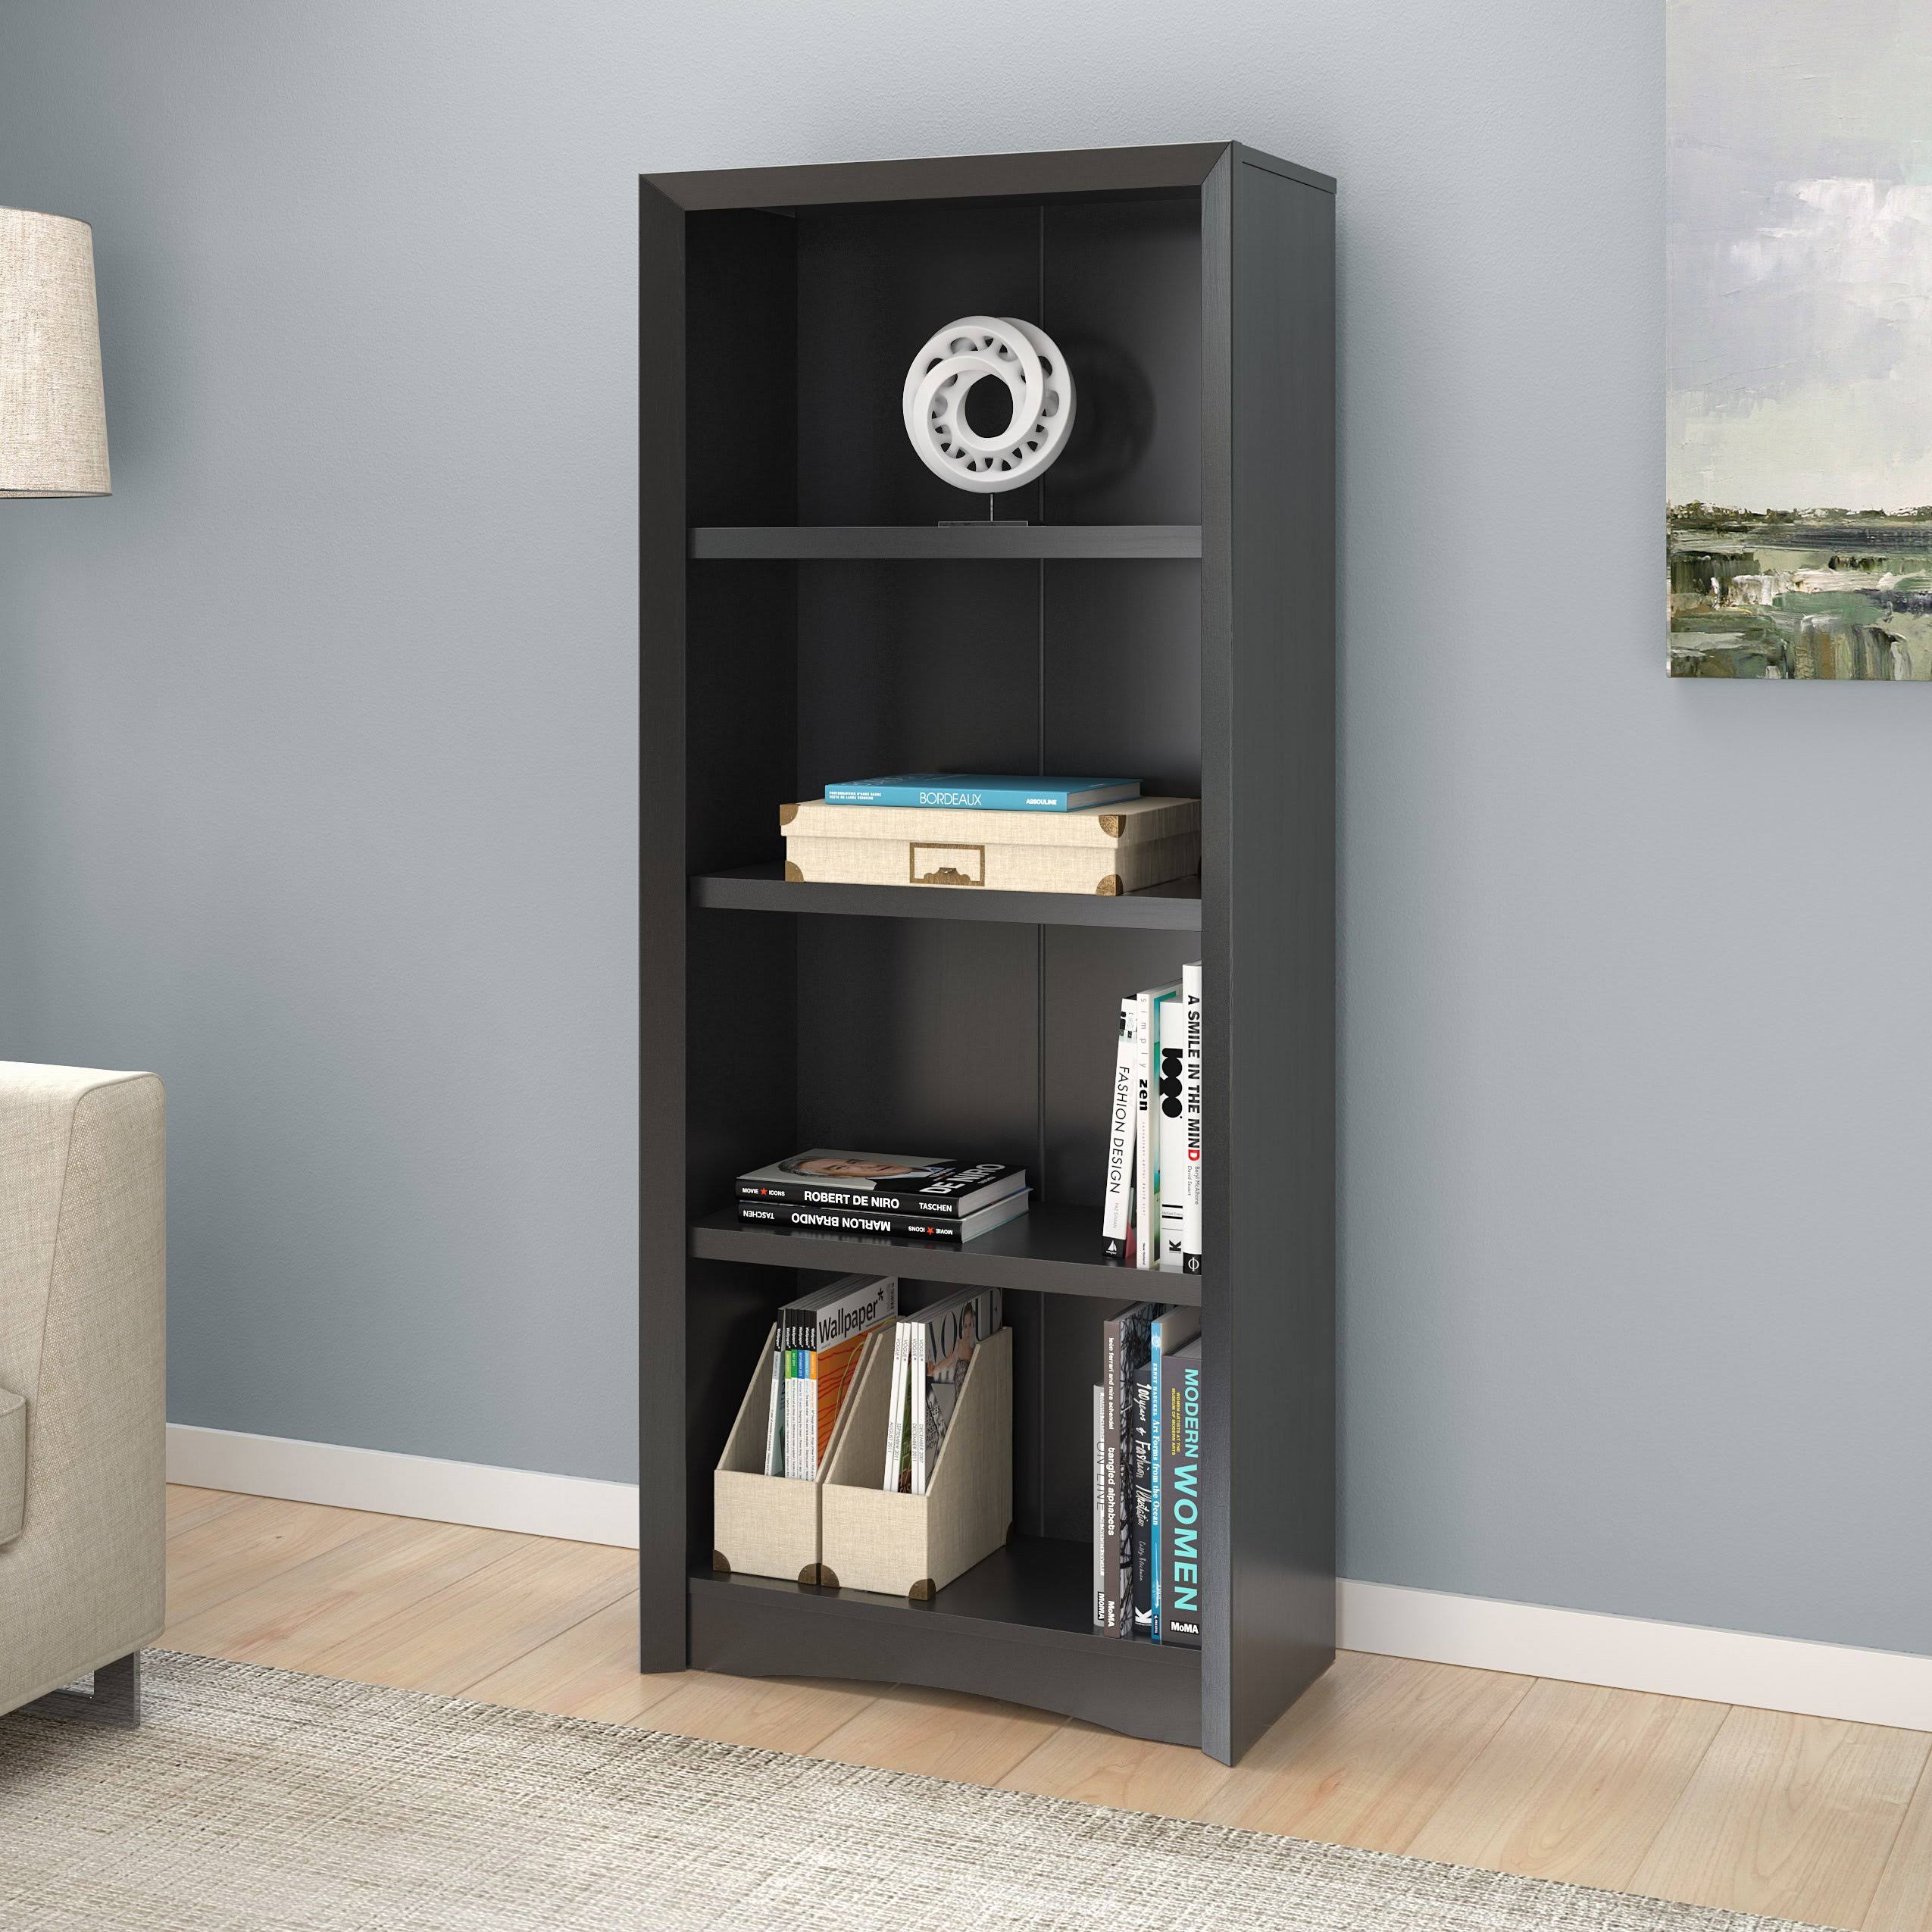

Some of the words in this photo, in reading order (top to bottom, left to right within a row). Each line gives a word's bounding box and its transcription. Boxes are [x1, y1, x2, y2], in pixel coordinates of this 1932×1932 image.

[919, 792, 982, 806] BORDEAUX
[1188, 995, 1200, 1005] A
[1188, 1011, 1200, 1058] SMILE
[1188, 1064, 1200, 1080] IN
[1114, 1066, 1130, 1133] FASHION
[1139, 1079, 1148, 1111] zen
[1188, 1085, 1200, 1113] THE
[1188, 1118, 1200, 1161] MIND
[919, 1181, 966, 1194] DE
[946, 1164, 1005, 1183] NIRO
[1110, 1137, 1124, 1194] DESIGN
[804, 1190, 851, 1205] ROBERT
[852, 1194, 869, 1207] DE
[871, 1196, 900, 1209] NIRO
[918, 1202, 952, 1212] TASCHEN
[743, 1210, 774, 1220] TASCHEN
[791, 1212, 839, 1227] BRANDO
[842, 1217, 891, 1232] MARLON
[1169, 1240, 1182, 1252] K
[1184, 1368, 1199, 1458] MODERN
[1106, 1447, 1115, 1485] tangled
[1135, 1440, 1152, 1478] Fashion
[1107, 1487, 1116, 1536] alphabets
[1174, 1464, 1199, 1612] WOMEN
[1171, 1621, 1199, 1634] MoMA
